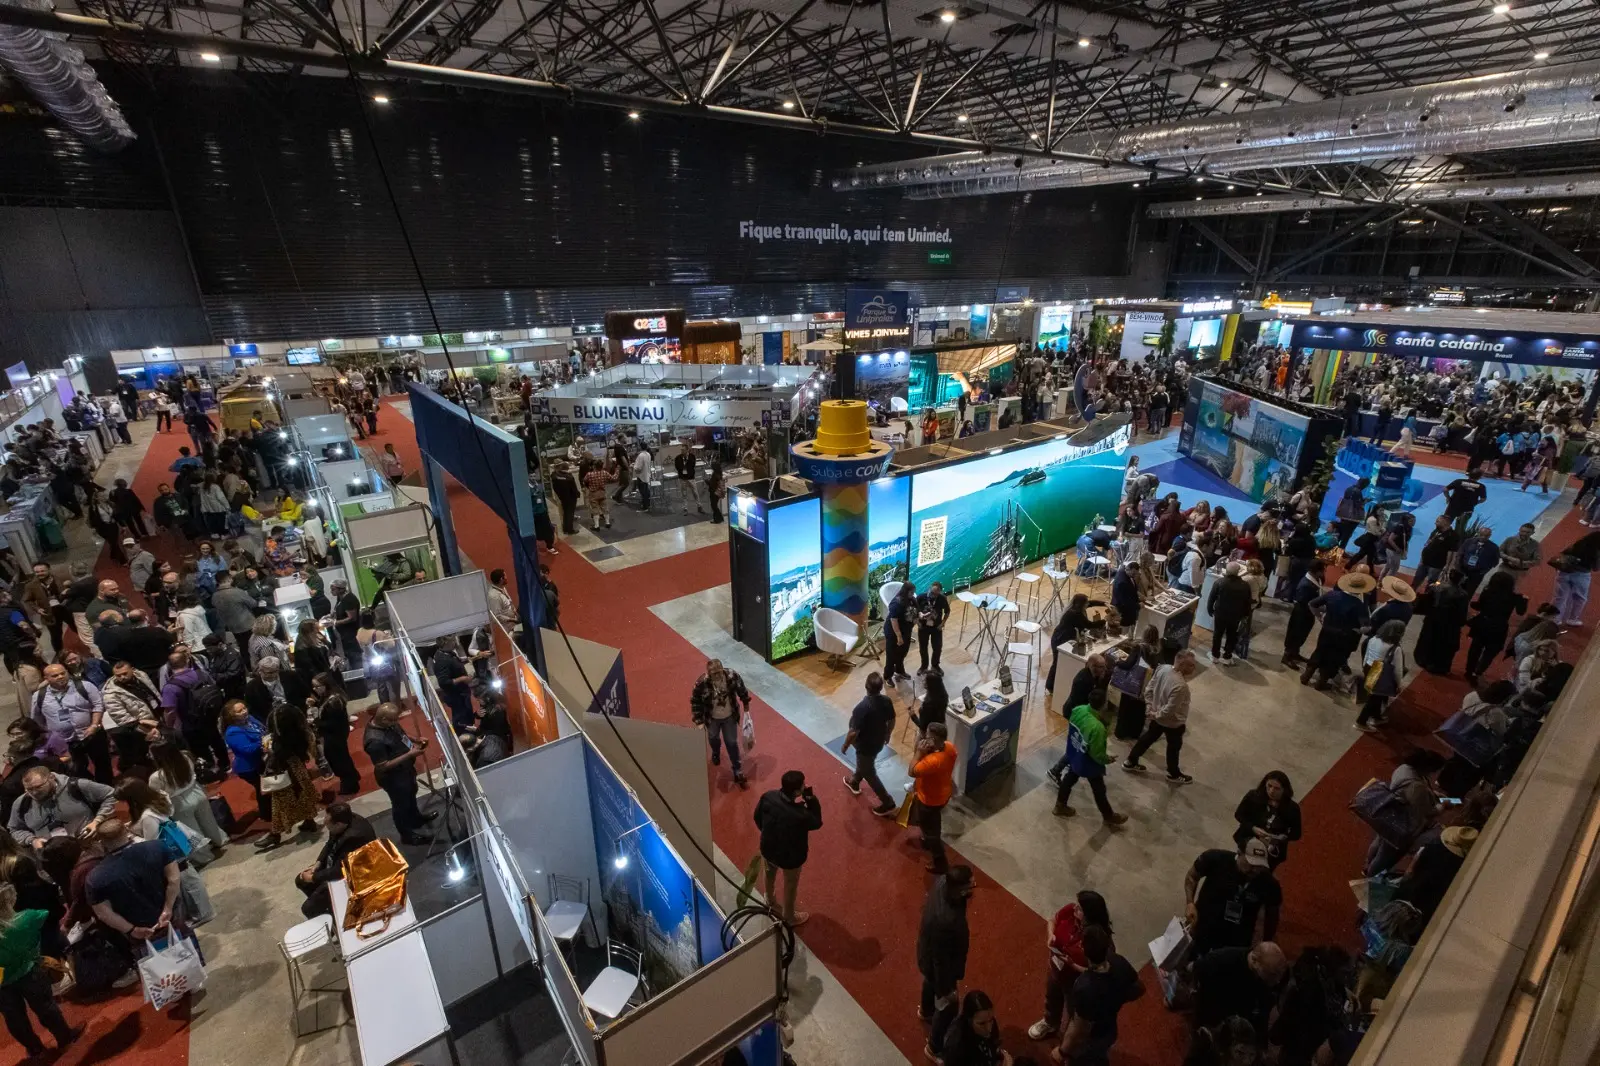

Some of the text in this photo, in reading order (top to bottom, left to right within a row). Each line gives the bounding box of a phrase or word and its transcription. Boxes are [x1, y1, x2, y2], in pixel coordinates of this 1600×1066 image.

[739, 220, 952, 245] Fique tranquilo, aqui tem Unimed.
[871, 327, 910, 337] JOINVILLE
[1395, 336, 1505, 352] santa catarina
